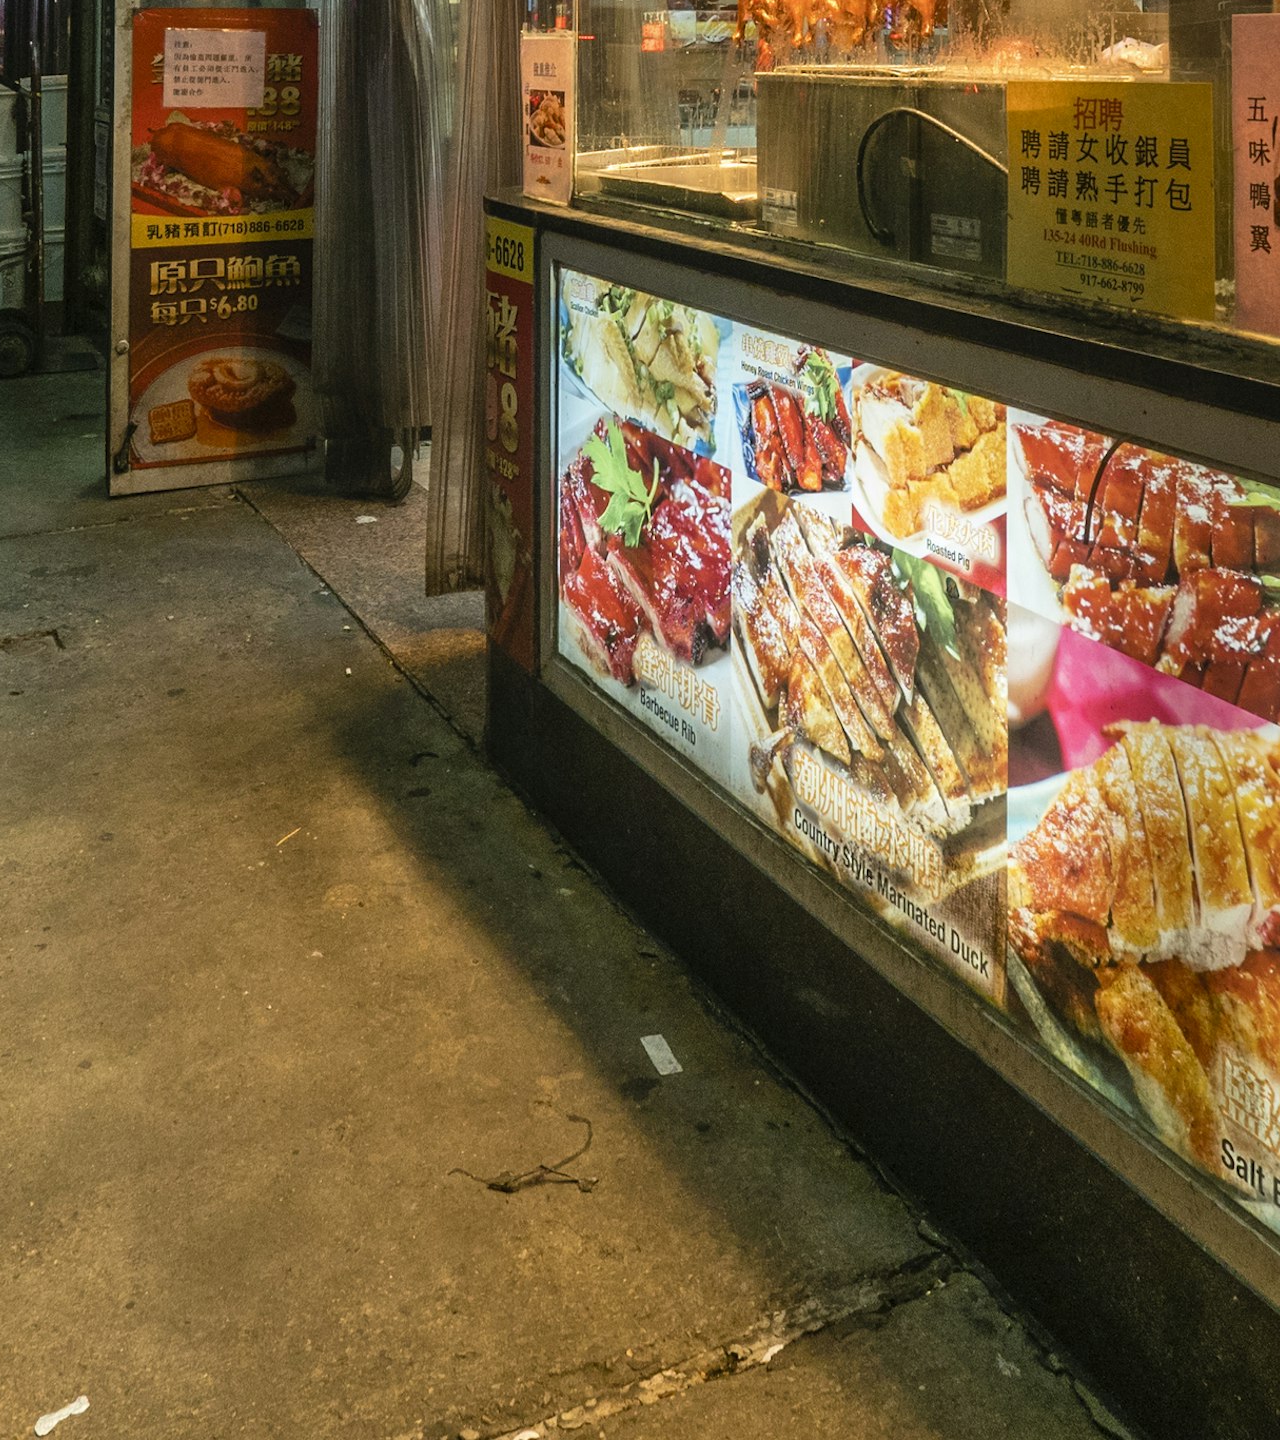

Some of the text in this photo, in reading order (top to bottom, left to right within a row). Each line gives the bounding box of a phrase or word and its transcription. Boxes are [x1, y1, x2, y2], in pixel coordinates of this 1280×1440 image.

[1073, 96, 1124, 132] 招聘
[1021, 129, 1192, 172] 聘請女收銀員
[1021, 165, 1192, 212] 聘請熟手打包
[1042, 228, 1158, 259] 135-24 40Rd Flushing
[1080, 272, 1145, 296] 917-662-8799
[758, 366, 773, 380] Roast
[773, 371, 796, 389] Chicken
[926, 537, 970, 571] Roasted Pig
[639, 686, 697, 748] Barbecue Rib
[793, 806, 990, 981] Country Style Marinated Duck
[1220, 1136, 1266, 1200] Salt
